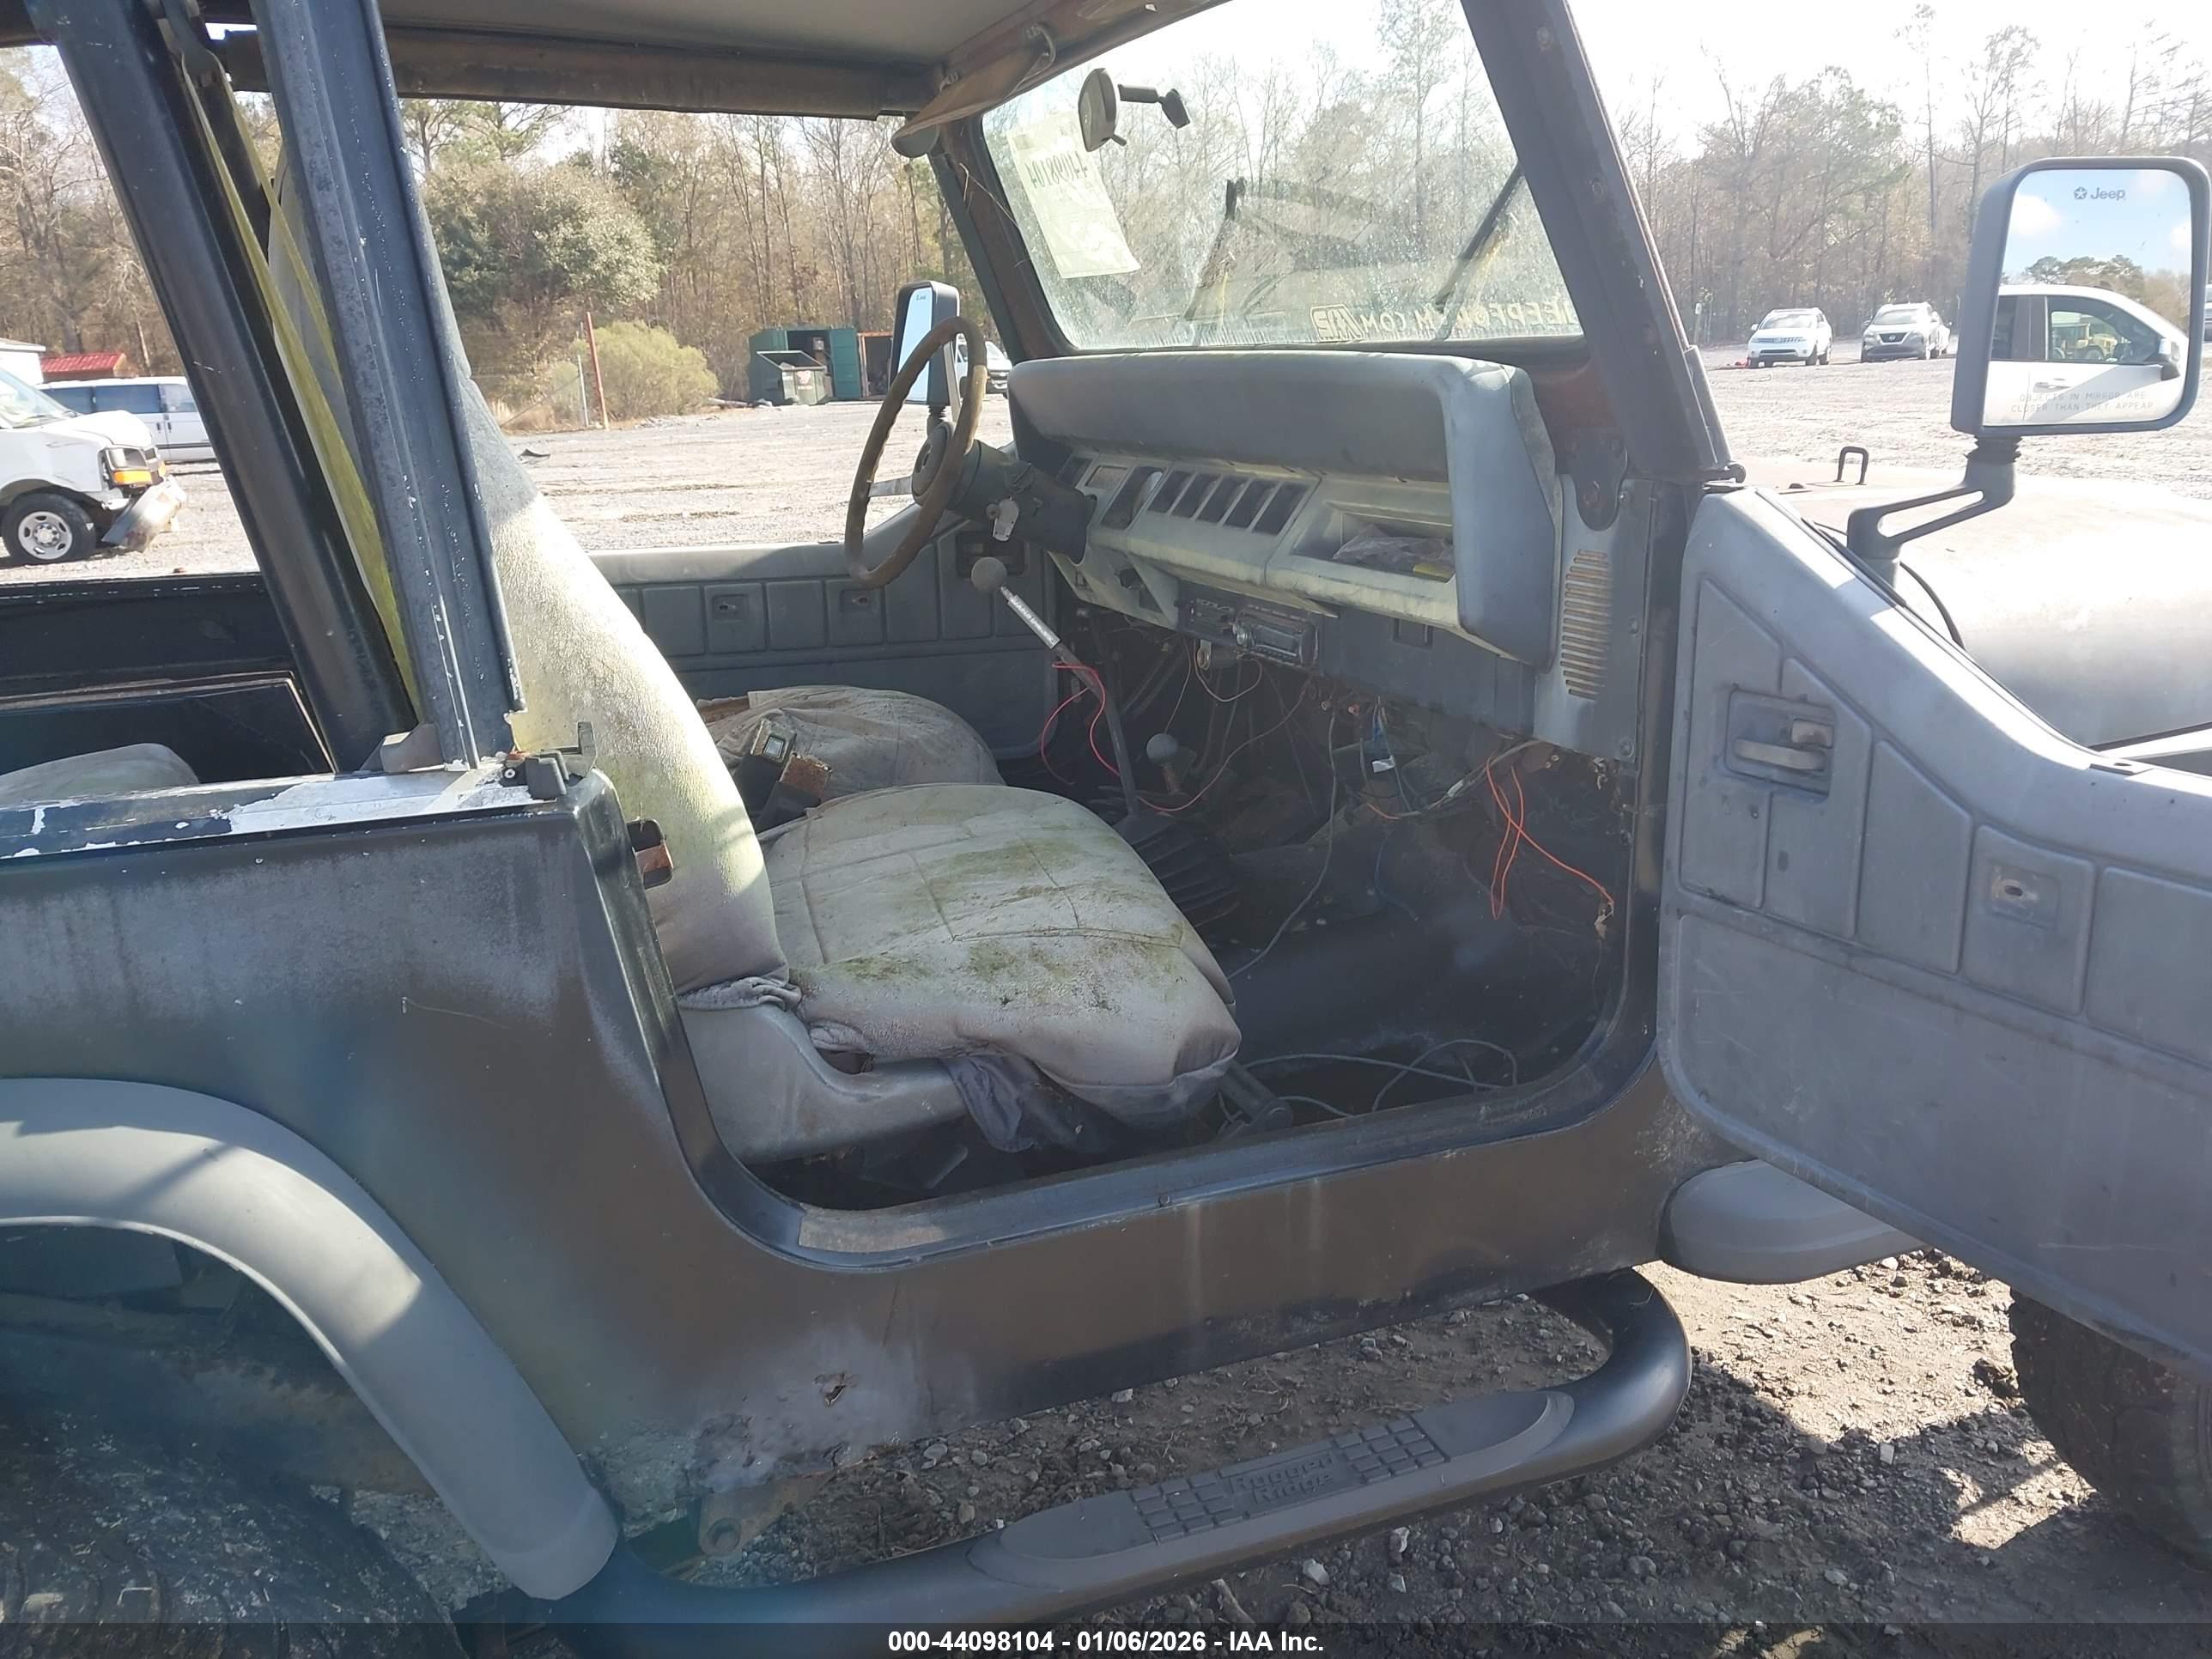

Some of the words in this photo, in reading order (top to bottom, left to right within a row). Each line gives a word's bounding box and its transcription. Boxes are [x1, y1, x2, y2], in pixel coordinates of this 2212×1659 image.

[2090, 187, 2126, 201] Jeep
[2069, 392, 2080, 400] IN
[2085, 391, 2121, 400] MIRROR
[2128, 391, 2147, 400] ARE
[2011, 404, 2048, 413] CLOSER
[2054, 403, 2080, 411] THAN
[2115, 401, 2154, 410] APPEAR
